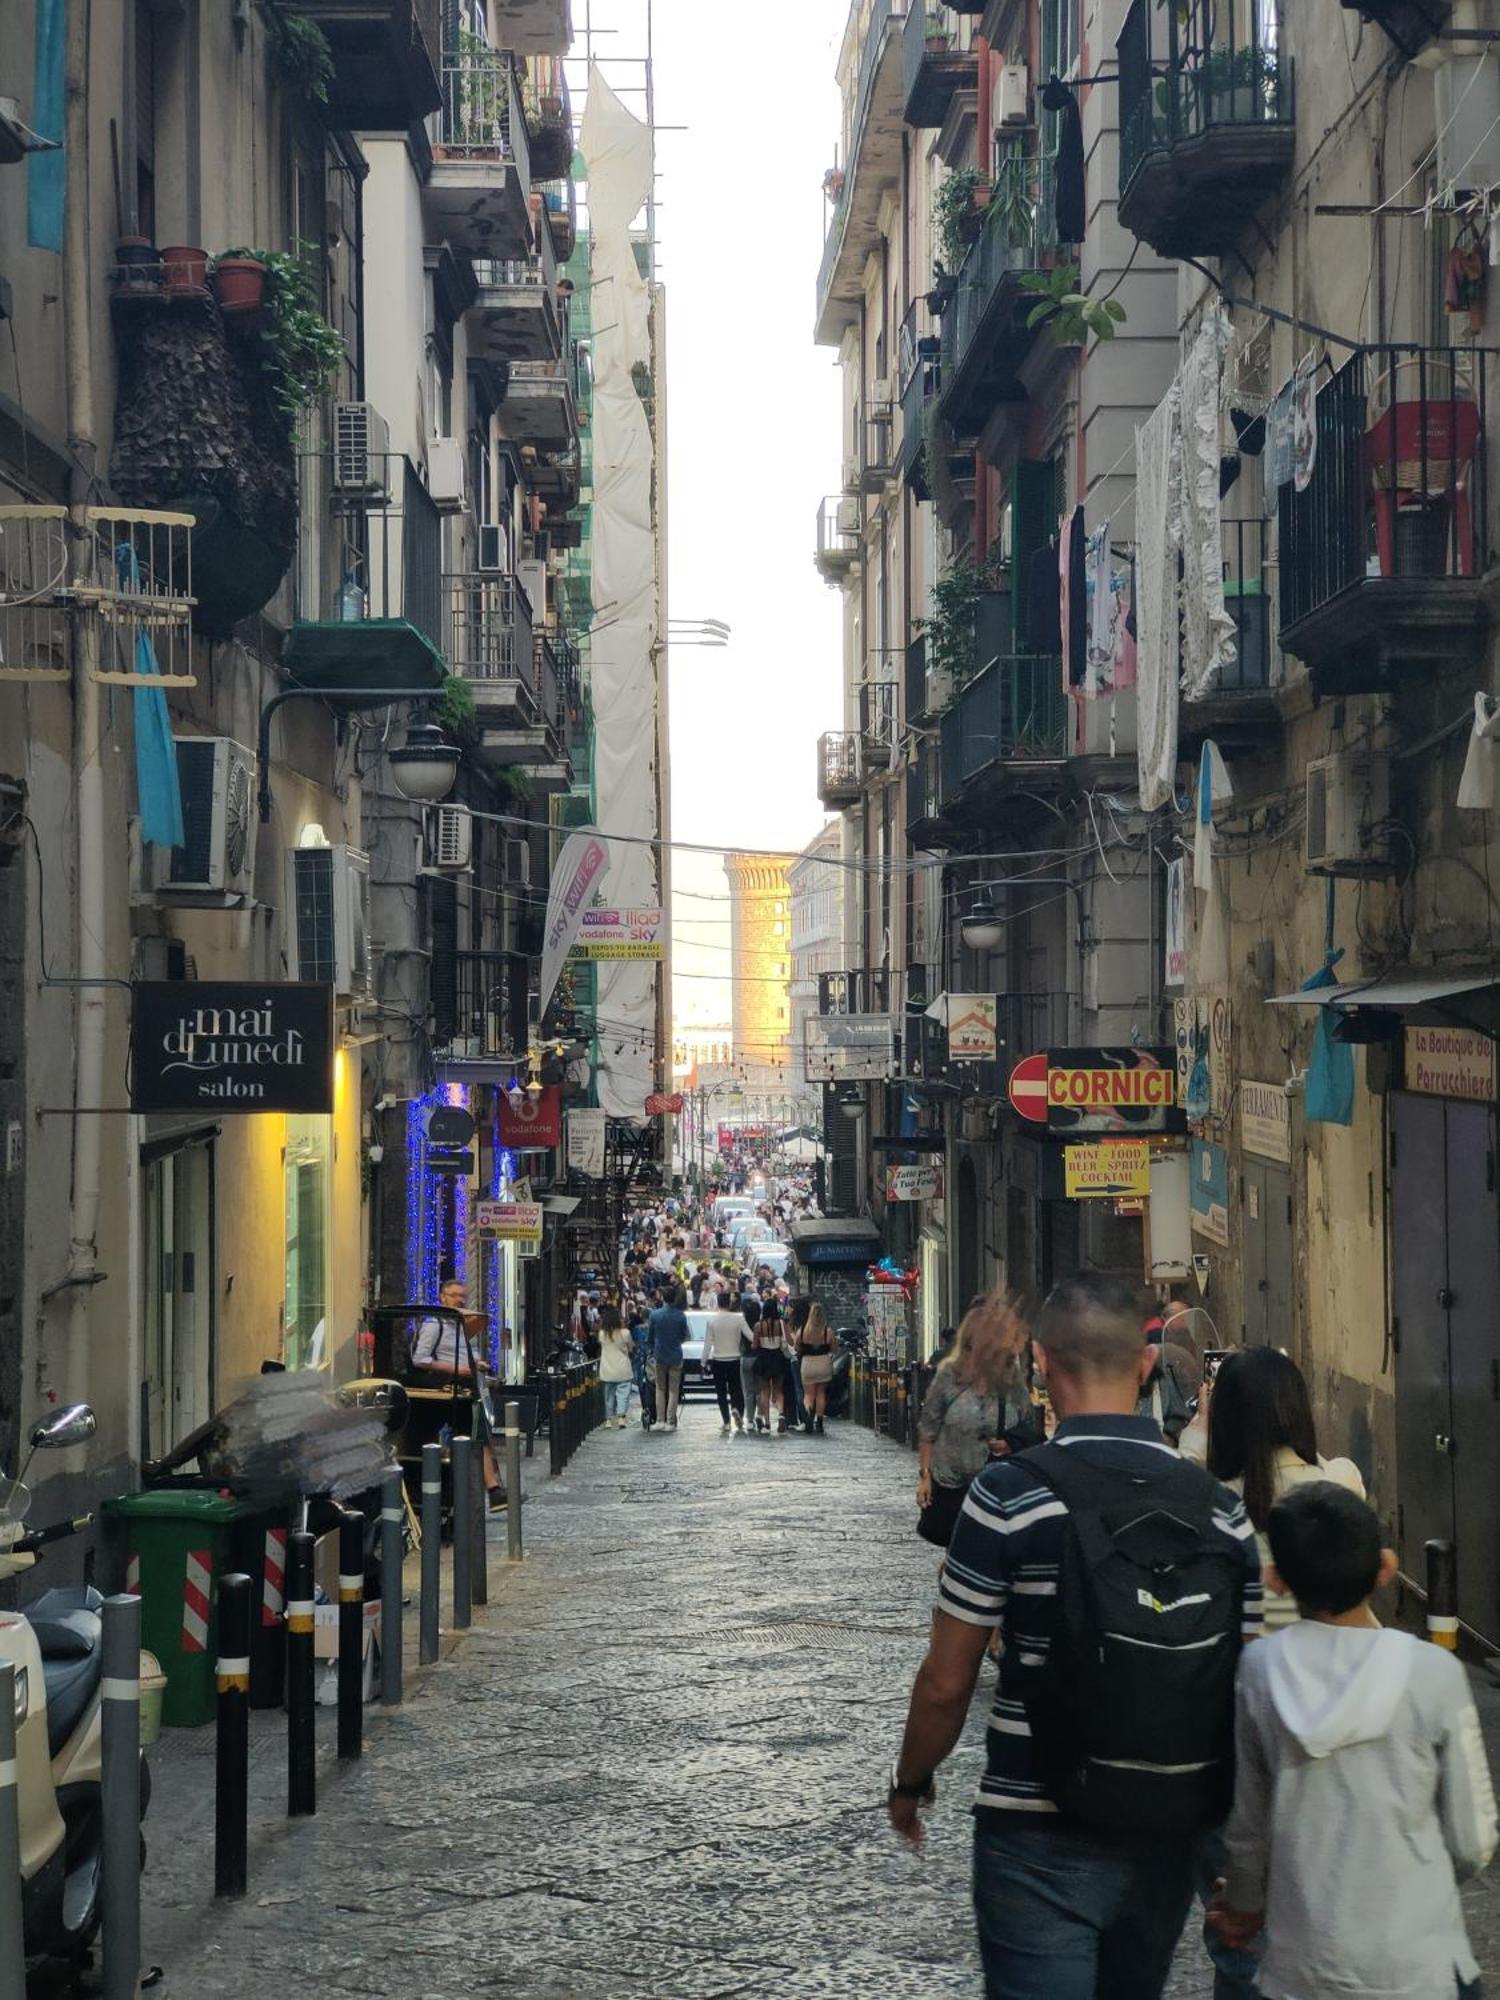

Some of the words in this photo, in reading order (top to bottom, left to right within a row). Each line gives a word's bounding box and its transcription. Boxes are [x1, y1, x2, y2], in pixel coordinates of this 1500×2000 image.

[579, 930, 624, 938] vodafone
[630, 927, 656, 943] sky
[192, 1000, 275, 1037] mai
[1429, 1031, 1473, 1062] Boutique
[198, 1076, 264, 1097] salon
[1050, 1071, 1171, 1103] CORNICI
[505, 1125, 553, 1134] vodafone
[1074, 1150, 1099, 1160] WINE
[1112, 1149, 1141, 1159] FOOD
[1069, 1162, 1097, 1171] BEER
[1108, 1161, 1146, 1170] SPRITZ
[1081, 1173, 1133, 1183] COCKTAIL
